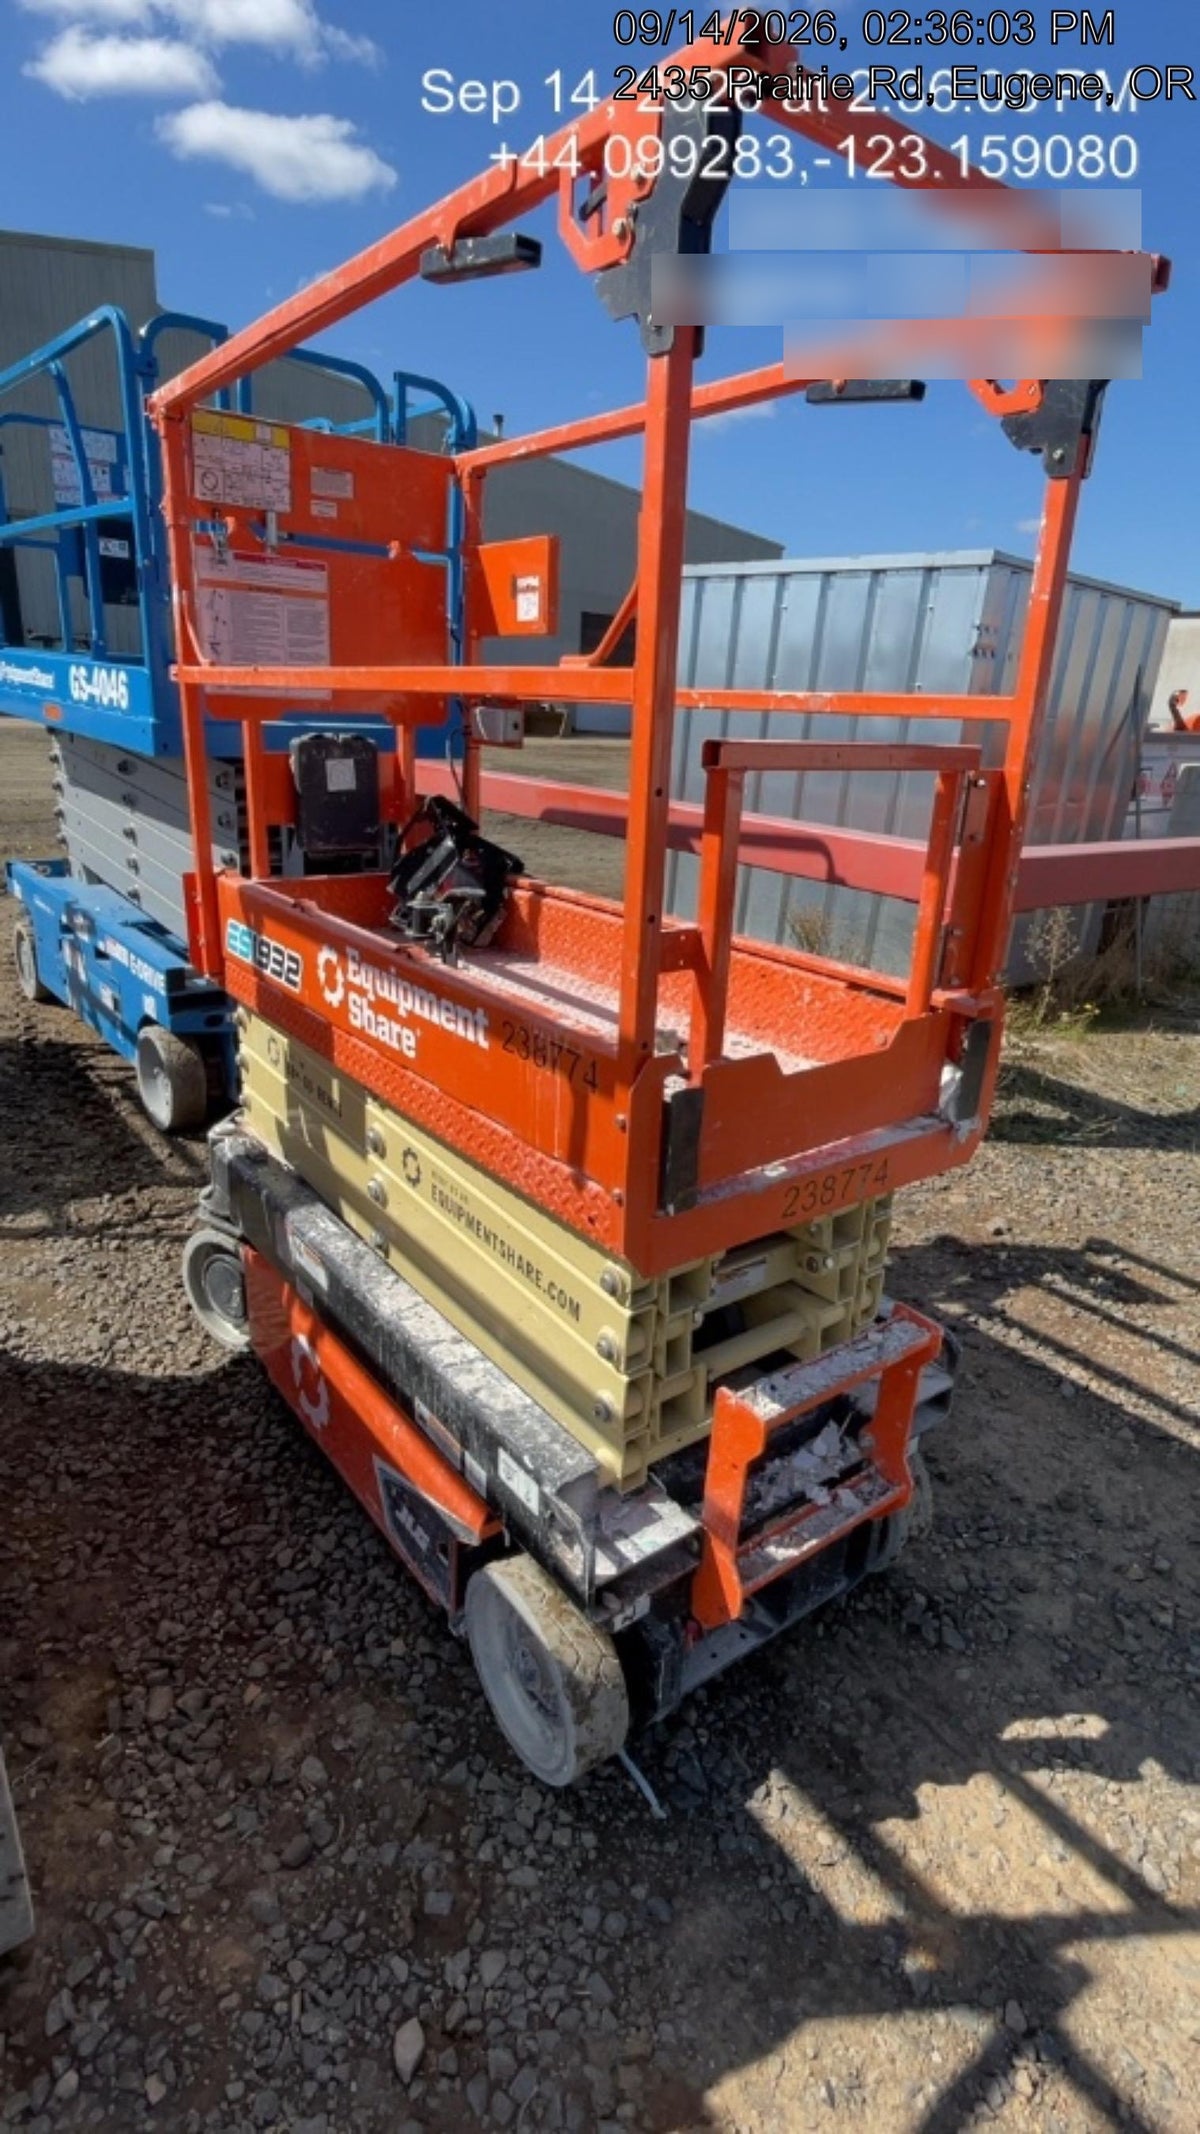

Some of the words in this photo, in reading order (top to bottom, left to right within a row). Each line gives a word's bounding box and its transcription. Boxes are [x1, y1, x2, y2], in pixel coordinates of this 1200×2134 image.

[69, 664, 129, 710] GS-4046
[227, 918, 304, 994] ES1932
[346, 946, 490, 1050] Equipment
[348, 991, 417, 1058] Share
[502, 1020, 599, 1093] 238774
[782, 1158, 889, 1219] 238774
[430, 1182, 582, 1322] EQUIPMENTSHARE.COM
